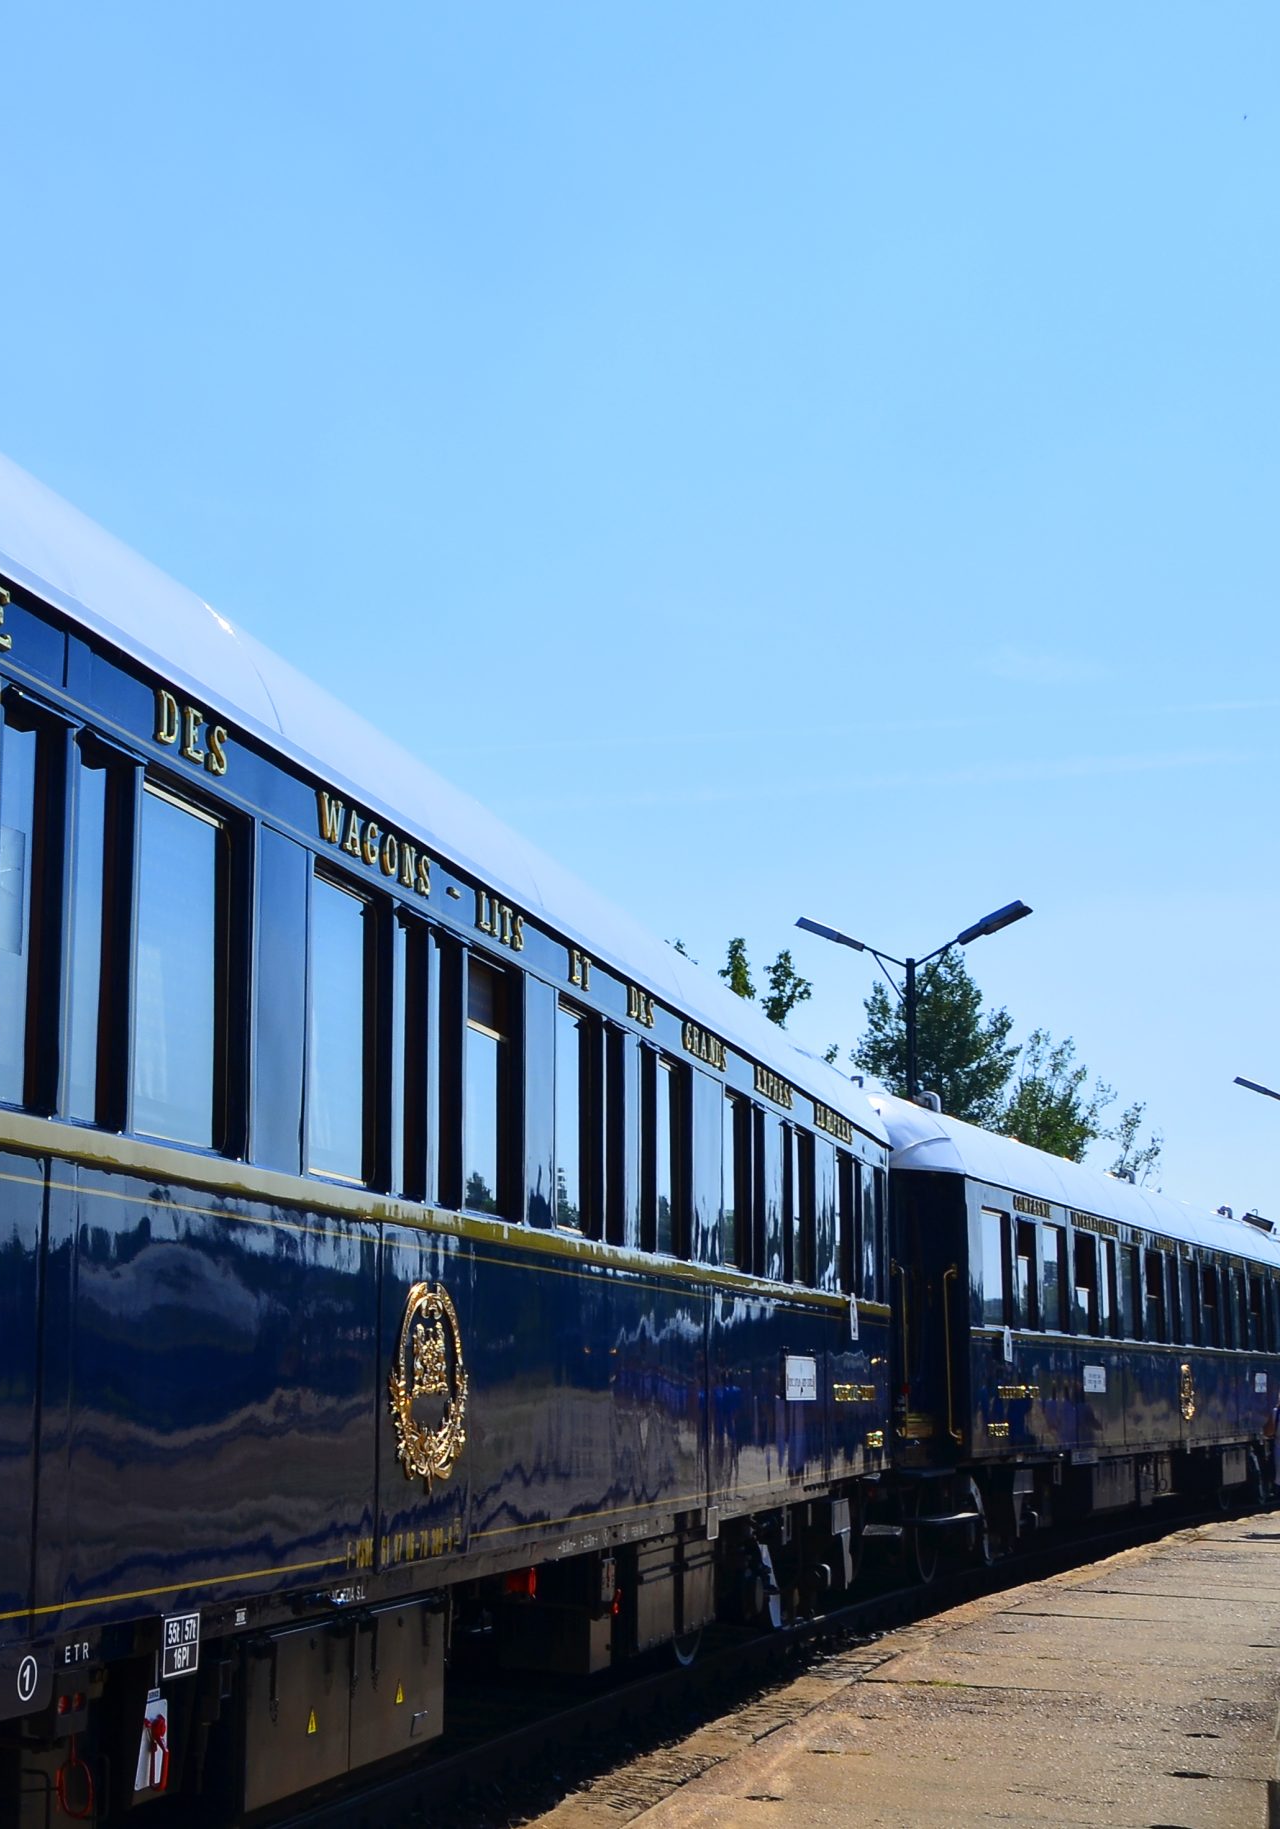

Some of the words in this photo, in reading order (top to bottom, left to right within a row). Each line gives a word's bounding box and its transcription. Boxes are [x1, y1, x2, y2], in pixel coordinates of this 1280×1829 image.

[156, 688, 228, 776] DES
[318, 791, 432, 897] WAGONS
[475, 890, 524, 952] LITS
[568, 948, 593, 992] ET
[627, 985, 656, 1030] DES
[683, 1021, 727, 1072] GRANDS
[168, 1622, 180, 1644] 55t
[184, 1619, 196, 1641] 57t
[23, 1664, 30, 1691] 1
